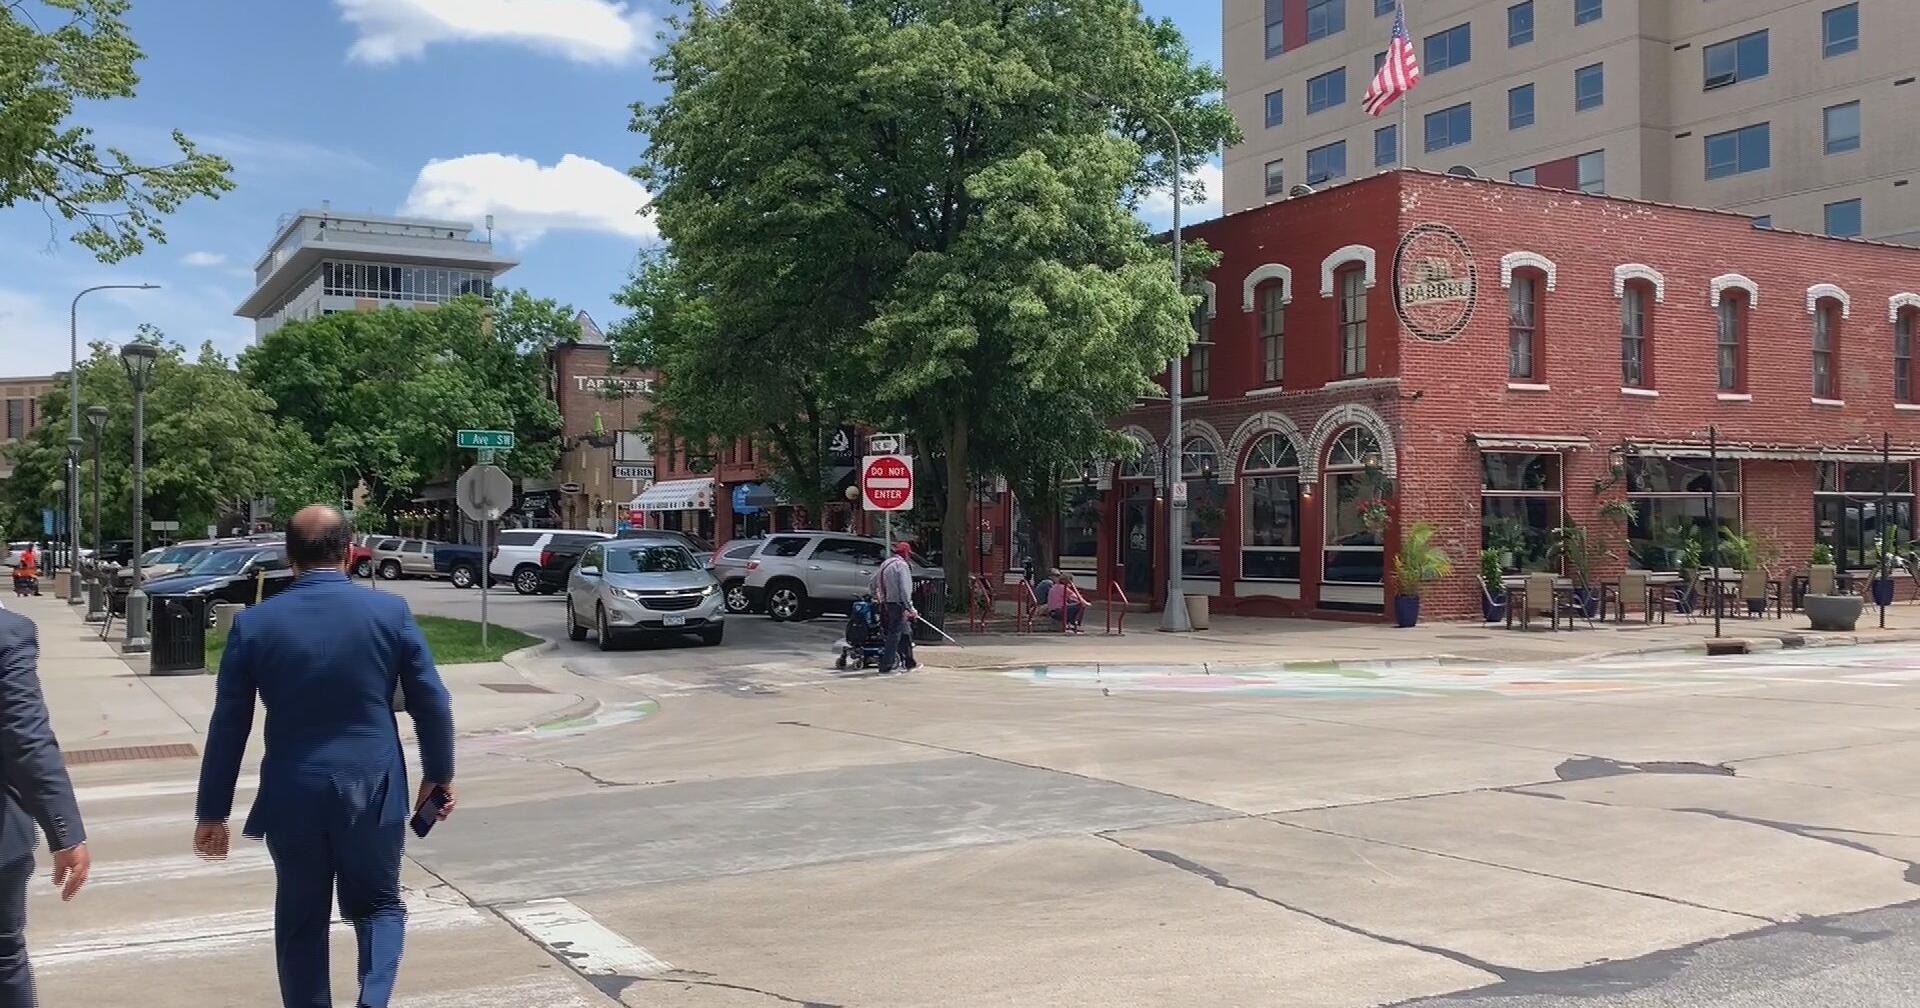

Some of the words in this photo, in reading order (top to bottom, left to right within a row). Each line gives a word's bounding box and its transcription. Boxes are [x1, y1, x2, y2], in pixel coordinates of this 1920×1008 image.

[1405, 282, 1467, 303] BARREL
[472, 432, 489, 445] Ave
[496, 433, 512, 446] SW
[621, 468, 653, 477] GUERIN
[871, 467, 883, 476] DO
[888, 467, 905, 476] NOT
[874, 490, 902, 499] ENTER
